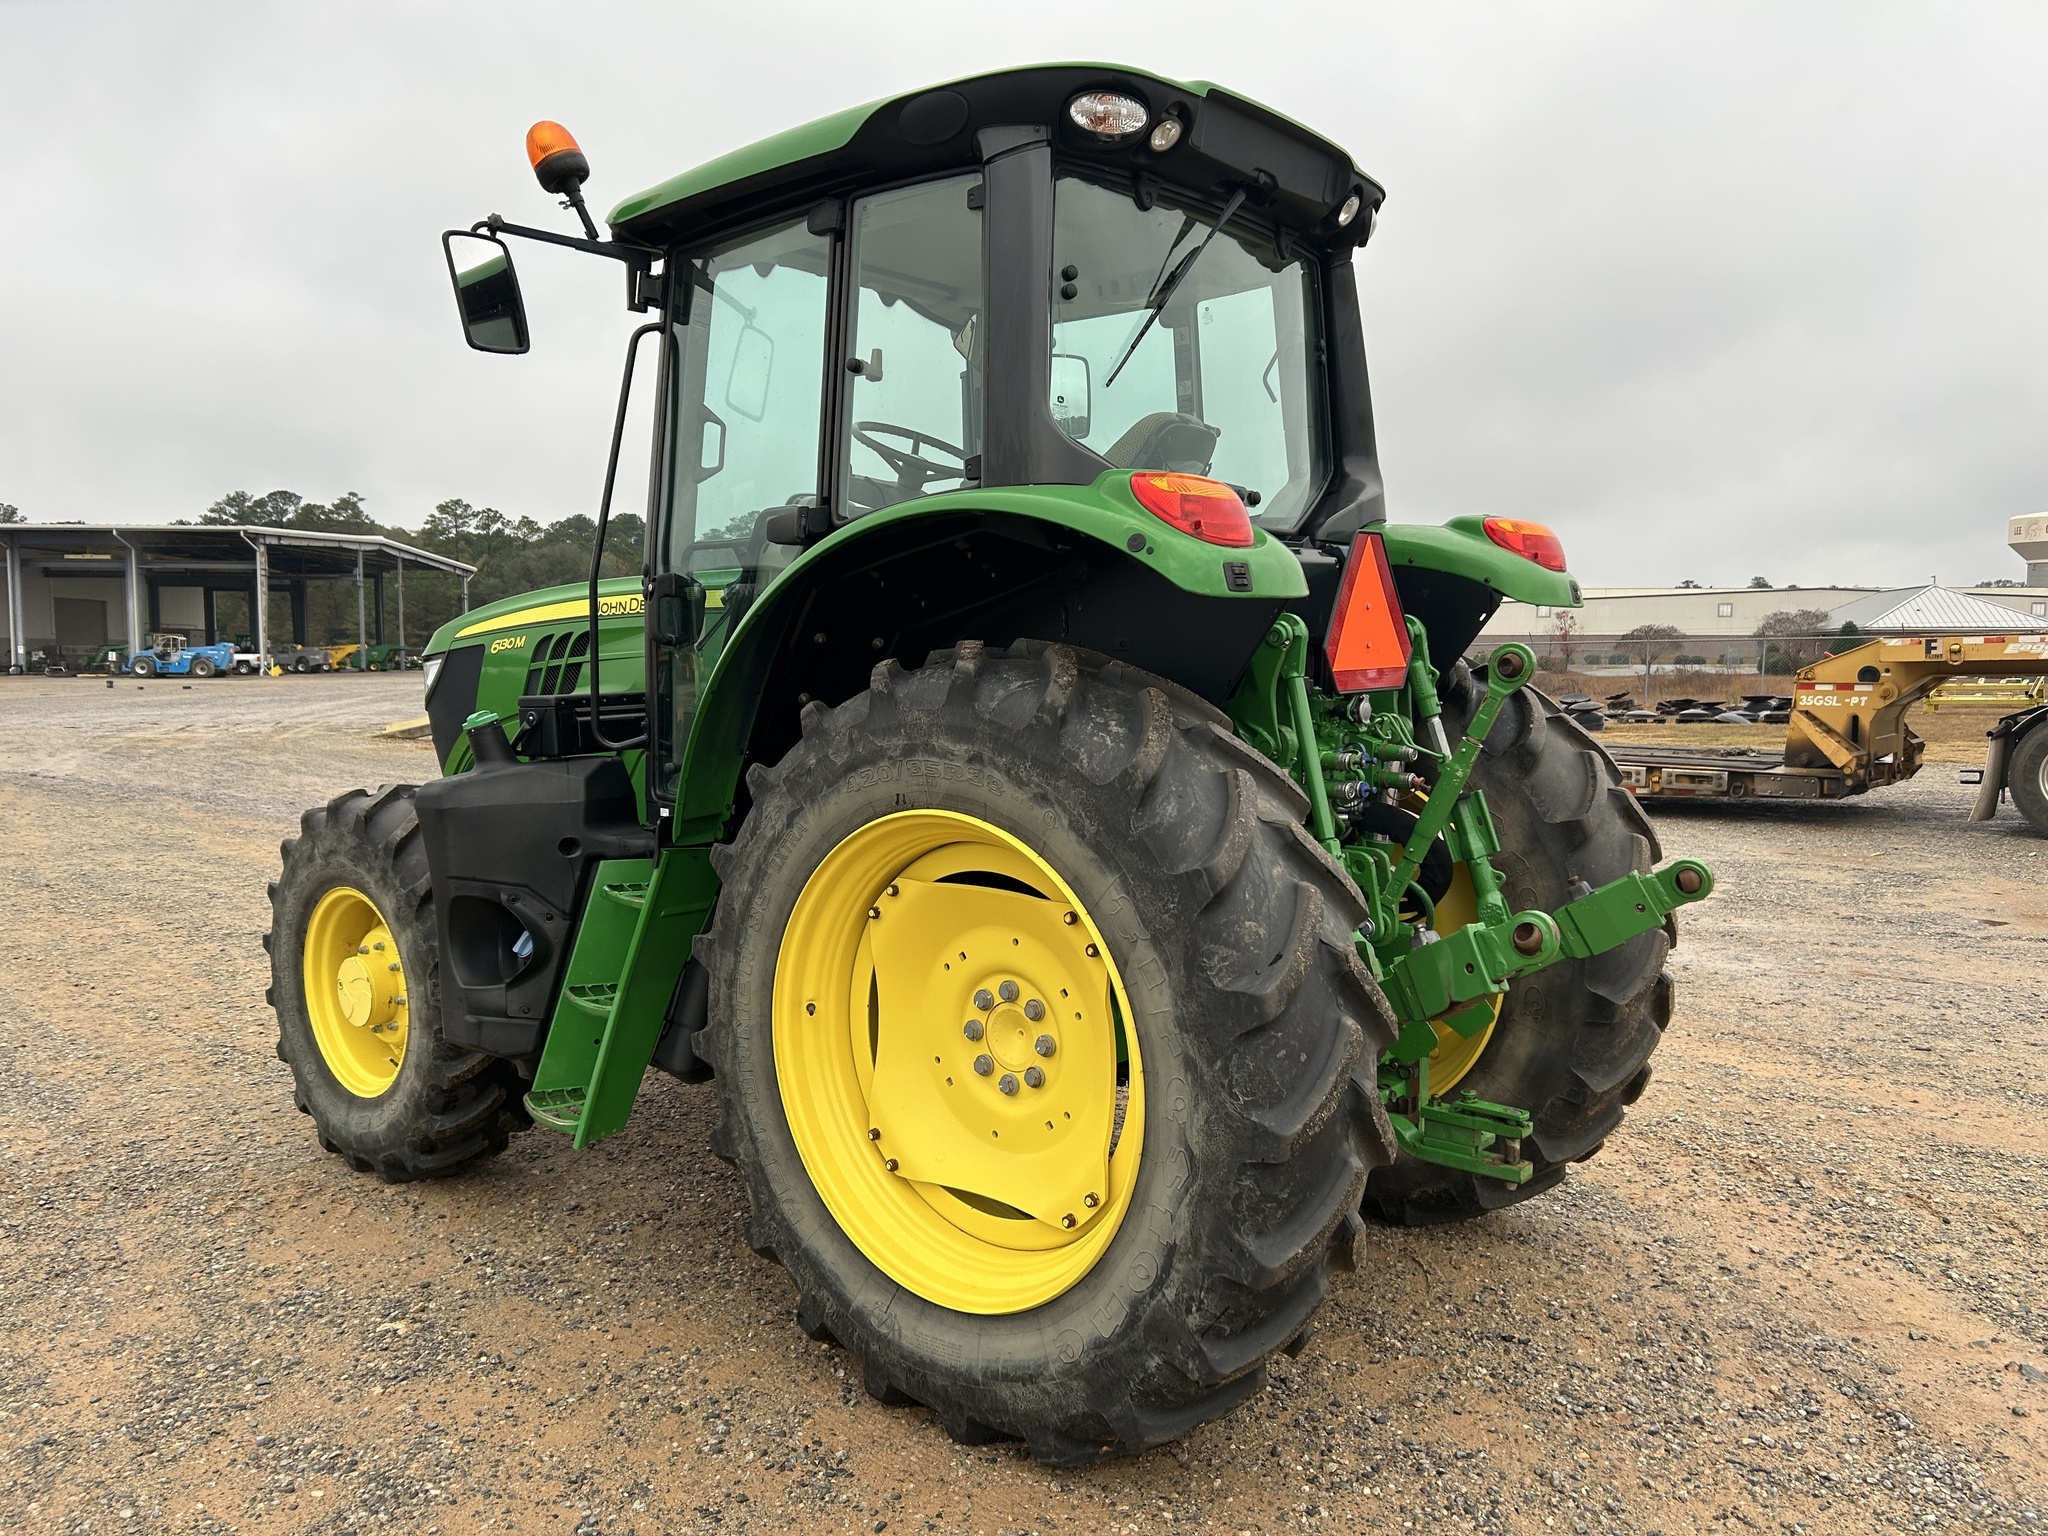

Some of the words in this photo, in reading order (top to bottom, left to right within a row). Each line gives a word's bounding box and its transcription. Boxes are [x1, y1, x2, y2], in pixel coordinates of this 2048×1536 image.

[1799, 695, 1841, 706] 35GSL
[844, 758, 1005, 796] 420/85R38
[768, 821, 808, 874] EXTRA
